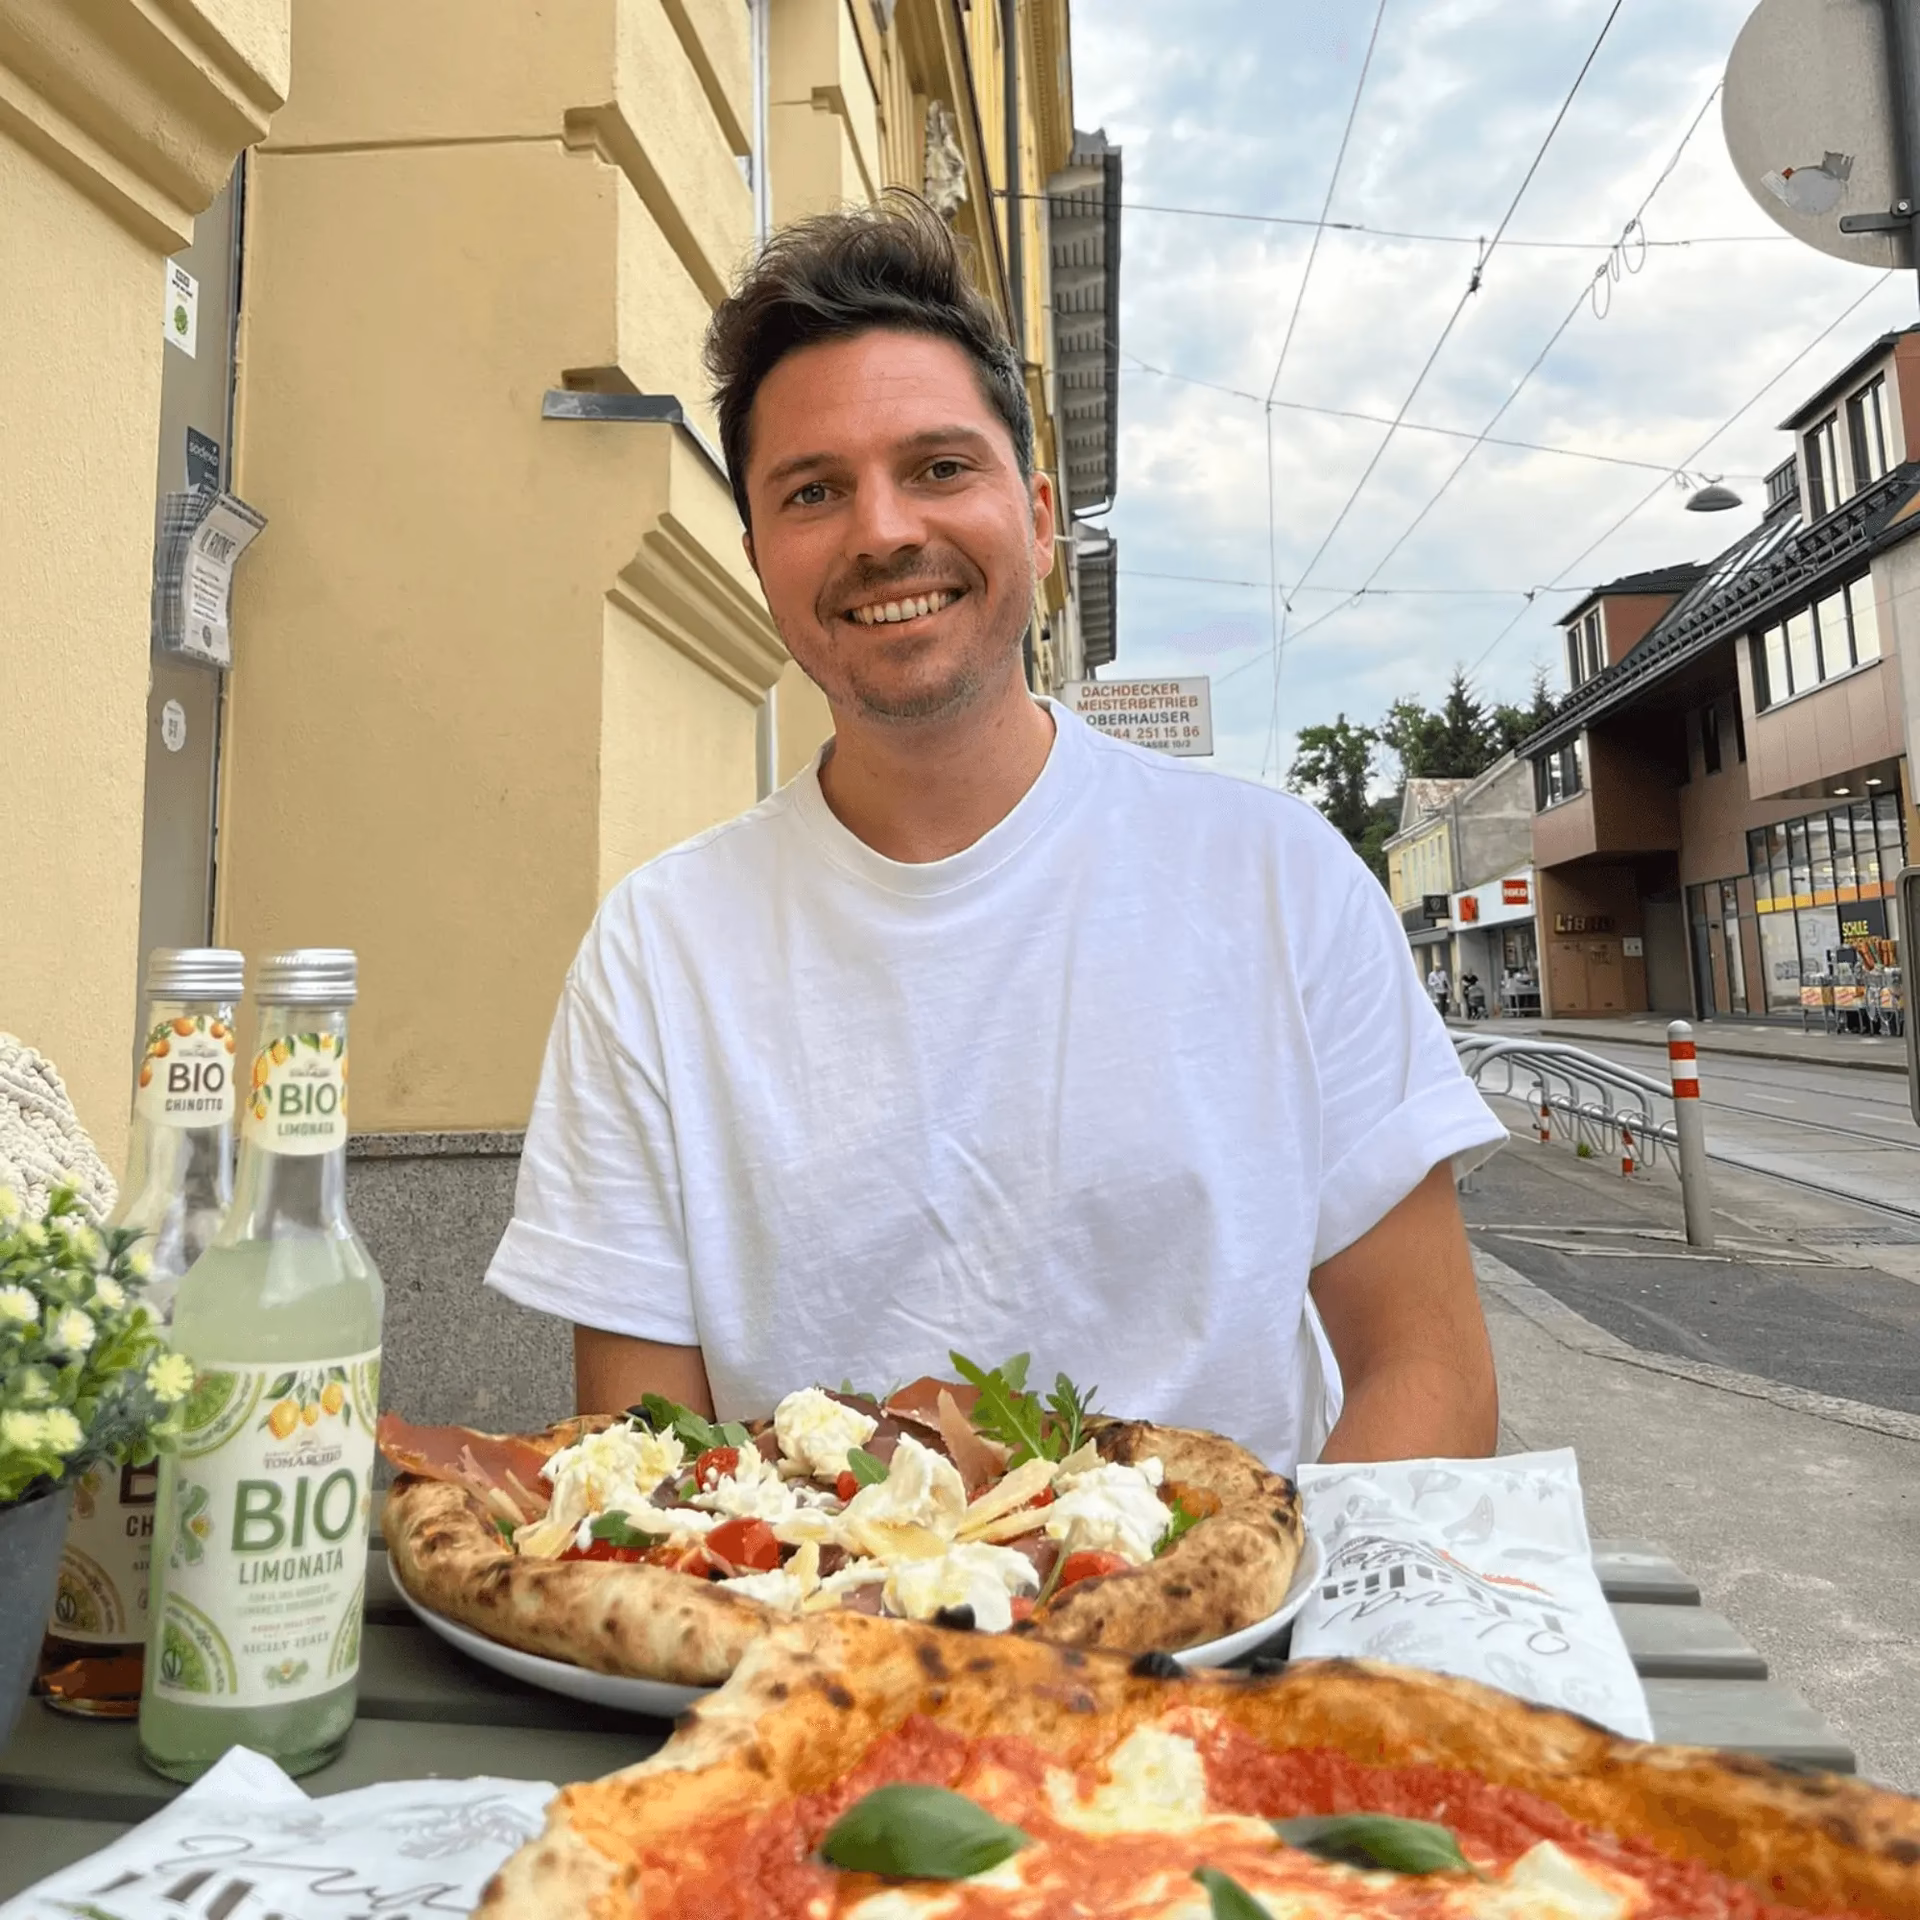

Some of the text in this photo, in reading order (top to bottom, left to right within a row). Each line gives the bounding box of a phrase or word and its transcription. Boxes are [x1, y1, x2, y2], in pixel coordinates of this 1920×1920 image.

[1081, 683, 1180, 699] DACHDECKER
[1076, 696, 1199, 711] MEISTERBETRIEB
[1086, 711, 1190, 726] OBERHAUSER
[1136, 727, 1160, 739] 251
[1164, 727, 1178, 737] 15
[1183, 725, 1200, 737] 86
[1842, 920, 1869, 937] SCHULE
[168, 1062, 225, 1094] BIO
[165, 1098, 223, 1112] CHINOTTO
[278, 1083, 338, 1116] BIO
[277, 1122, 334, 1137] LIMONATA
[231, 1467, 358, 1553] BIO
[239, 1548, 344, 1586] LIMONATA
